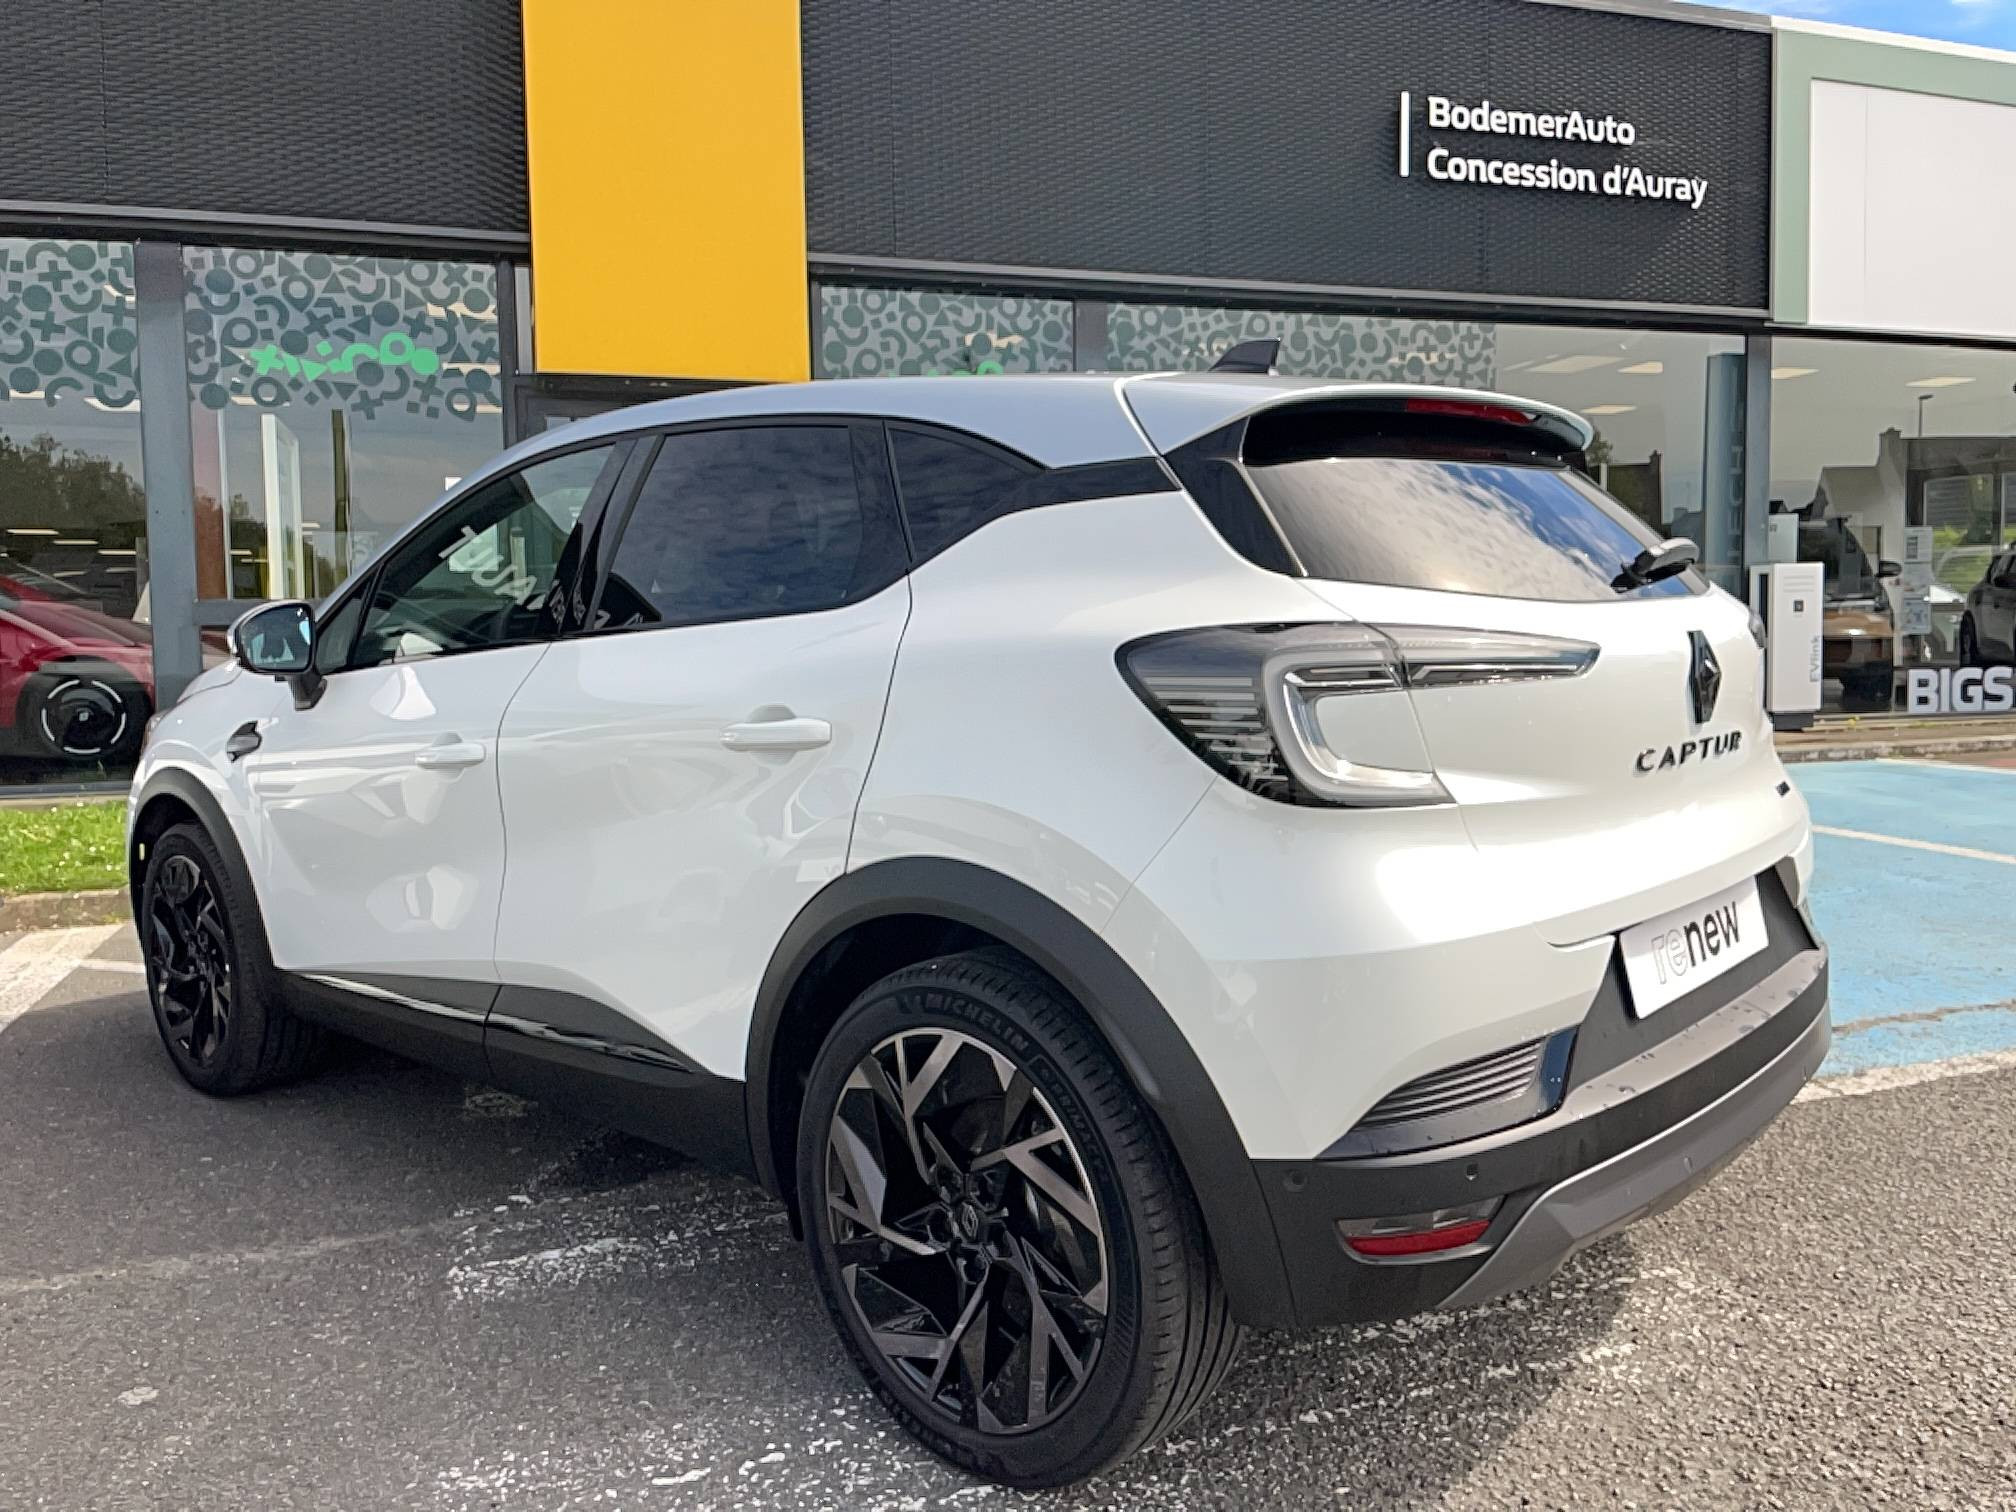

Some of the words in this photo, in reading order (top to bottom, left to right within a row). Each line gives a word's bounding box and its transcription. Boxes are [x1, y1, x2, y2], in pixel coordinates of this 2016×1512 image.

[1427, 96, 1636, 146] BodemerAuto
[1427, 148, 1598, 193] Concession
[1602, 164, 1708, 210] d'Auray
[1635, 730, 1742, 773] CAPTUR
[1650, 901, 1741, 986] renew
